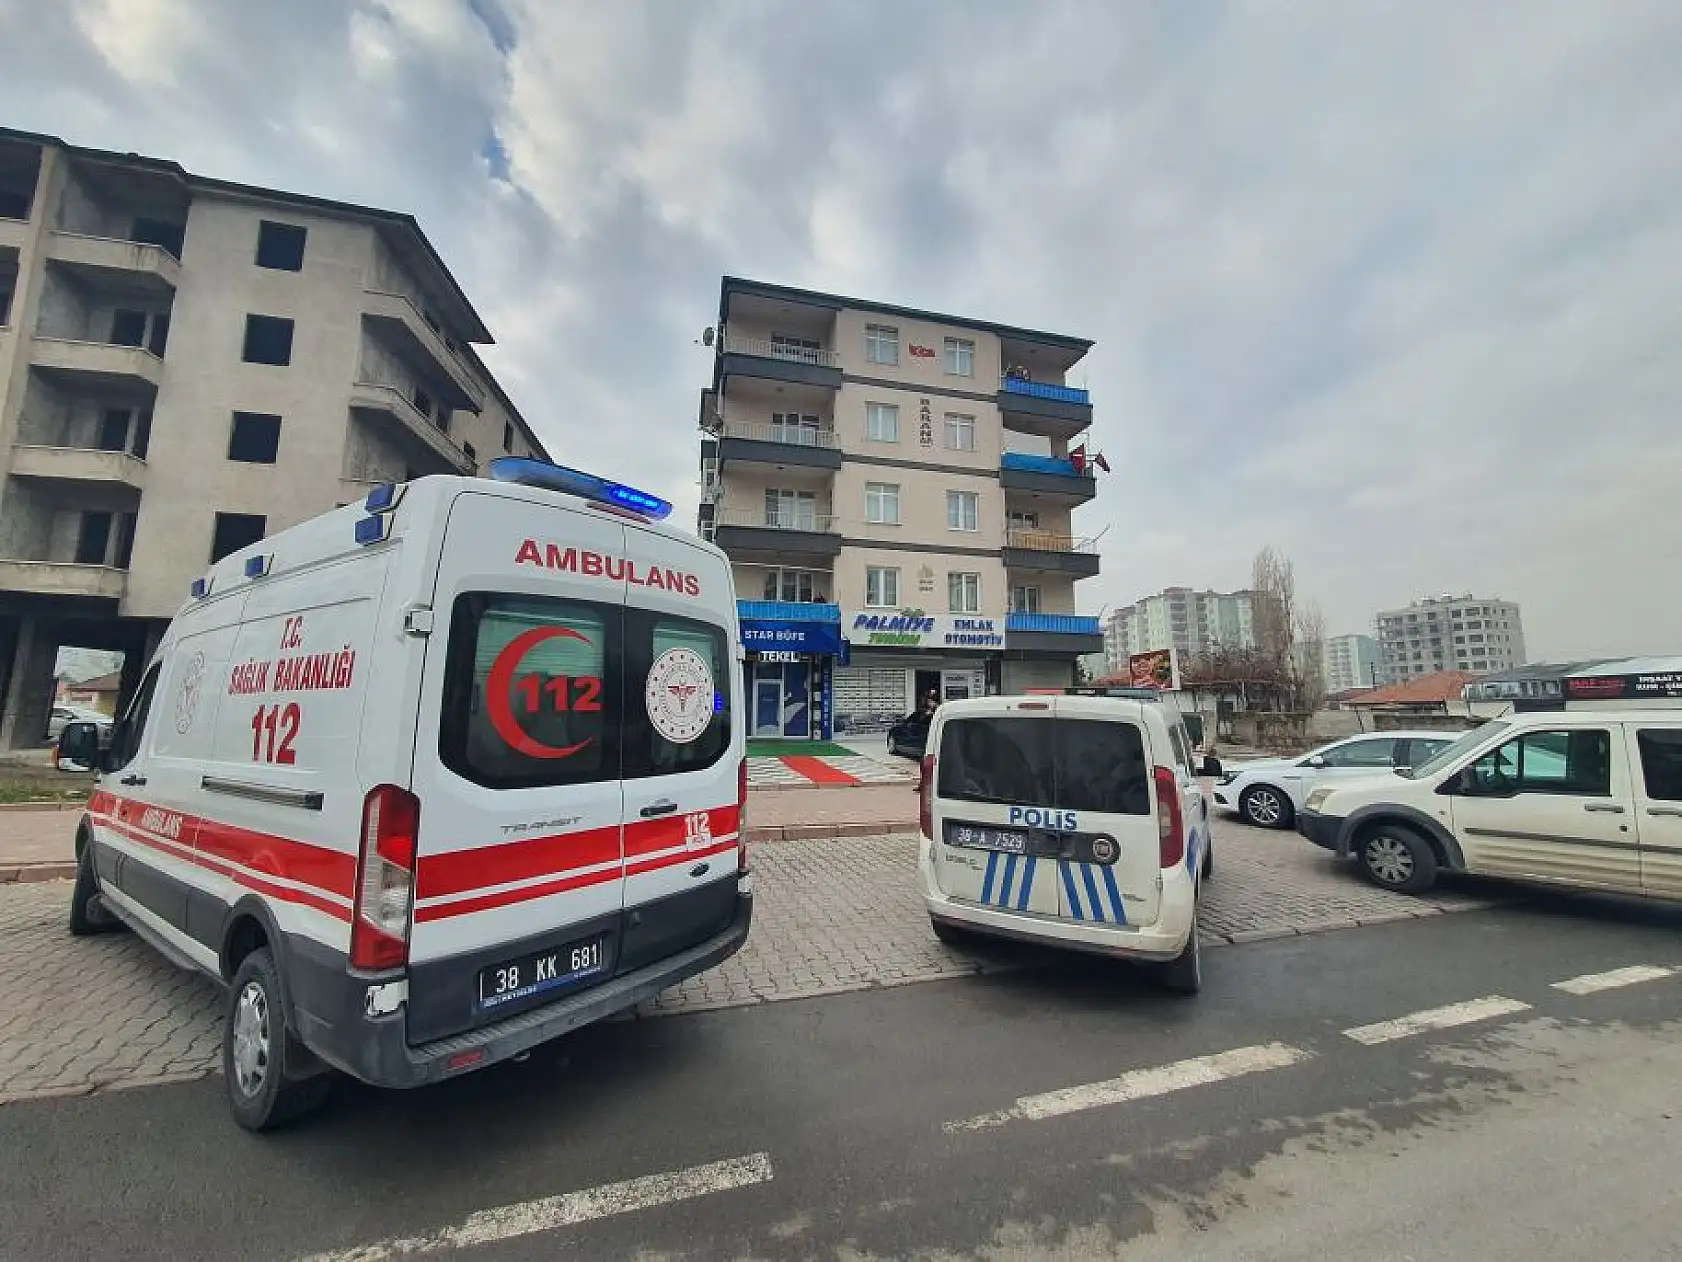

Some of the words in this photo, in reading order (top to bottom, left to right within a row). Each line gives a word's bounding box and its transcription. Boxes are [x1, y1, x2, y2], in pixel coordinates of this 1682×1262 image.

[515, 538, 700, 597] AMBULANS
[744, 630, 774, 640] STAR
[761, 650, 800, 662] TEKEL
[515, 675, 603, 713] 112
[251, 702, 301, 765] 112
[684, 812, 710, 835] 112
[496, 965, 520, 993] 38
[536, 954, 557, 982] KK
[571, 943, 598, 971] 681
